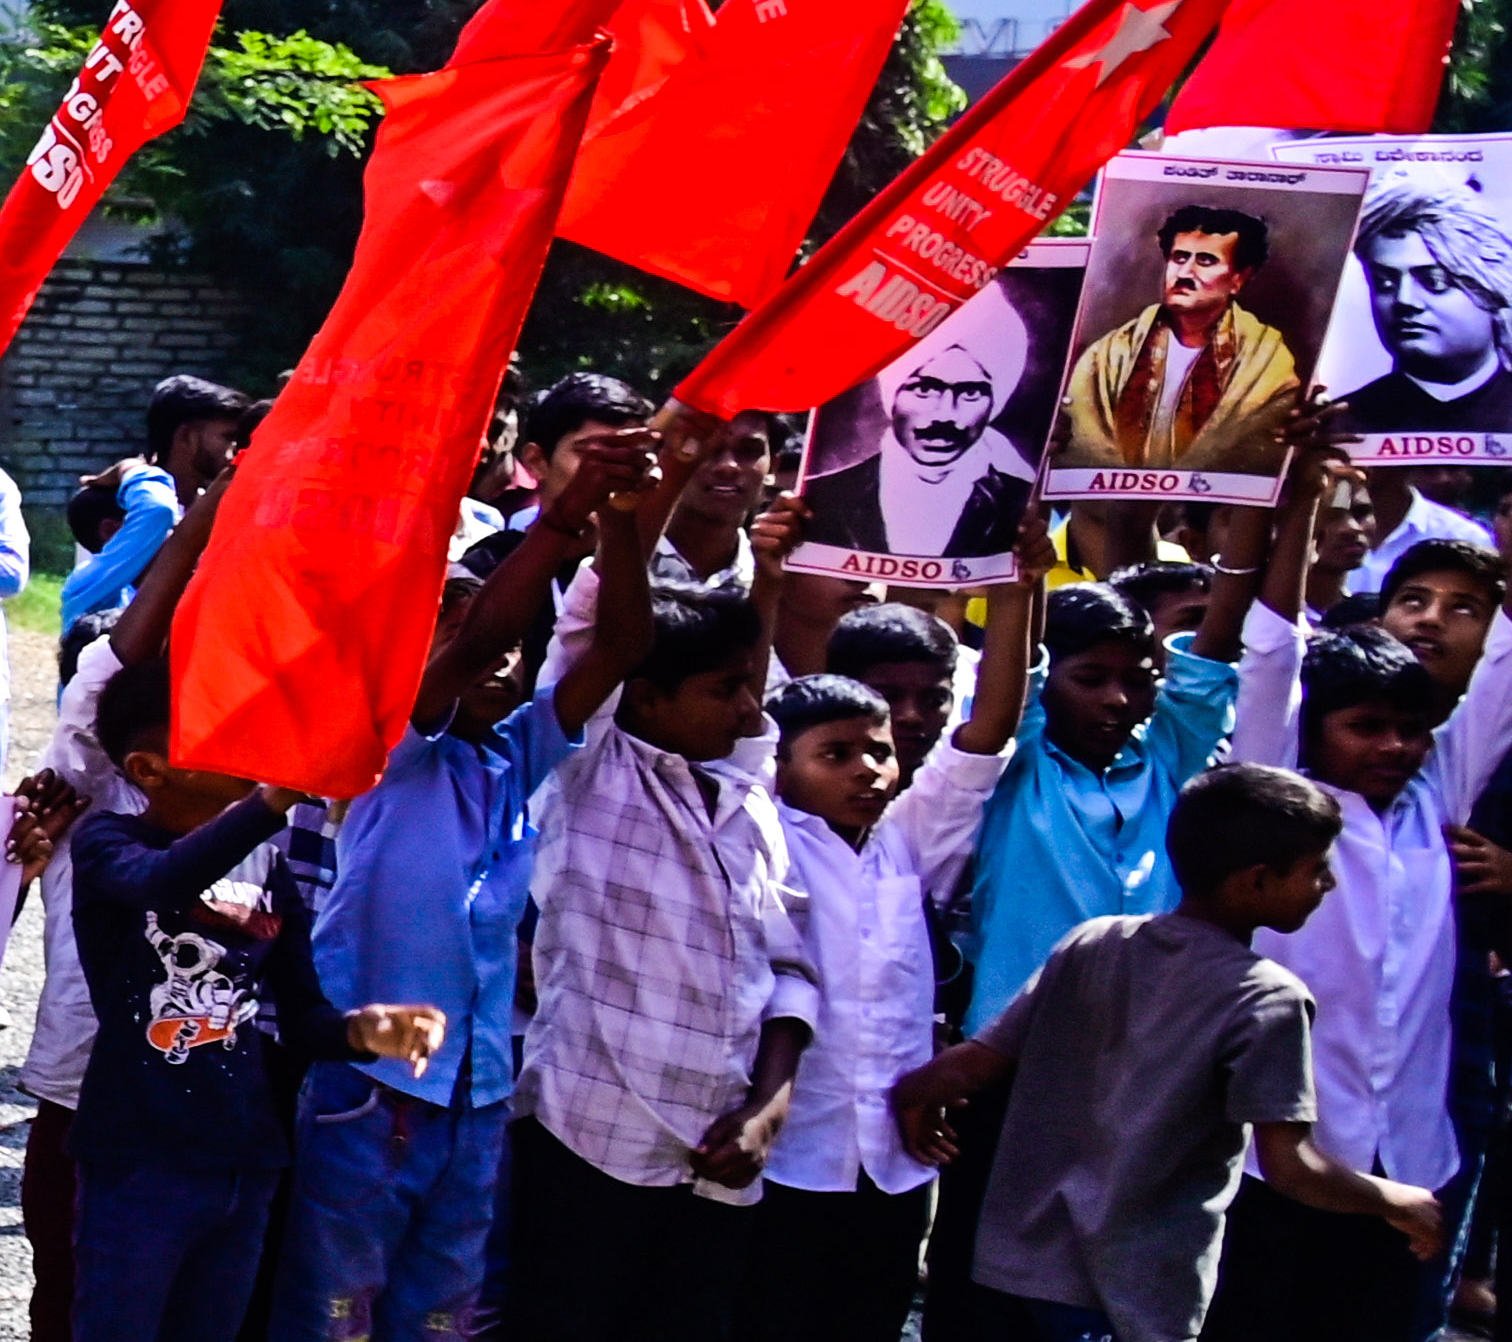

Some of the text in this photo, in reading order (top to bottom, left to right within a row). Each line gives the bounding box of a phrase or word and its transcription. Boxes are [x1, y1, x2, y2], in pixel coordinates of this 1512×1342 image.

[923, 181, 992, 232] UNITY
[957, 147, 1057, 221] STRUGGLE
[886, 214, 999, 289] PROGRESS
[836, 261, 951, 338] AIDSO
[1376, 435, 1475, 458] AIDSO
[1088, 471, 1182, 493] AIDSO
[841, 553, 942, 580] AIDSO
